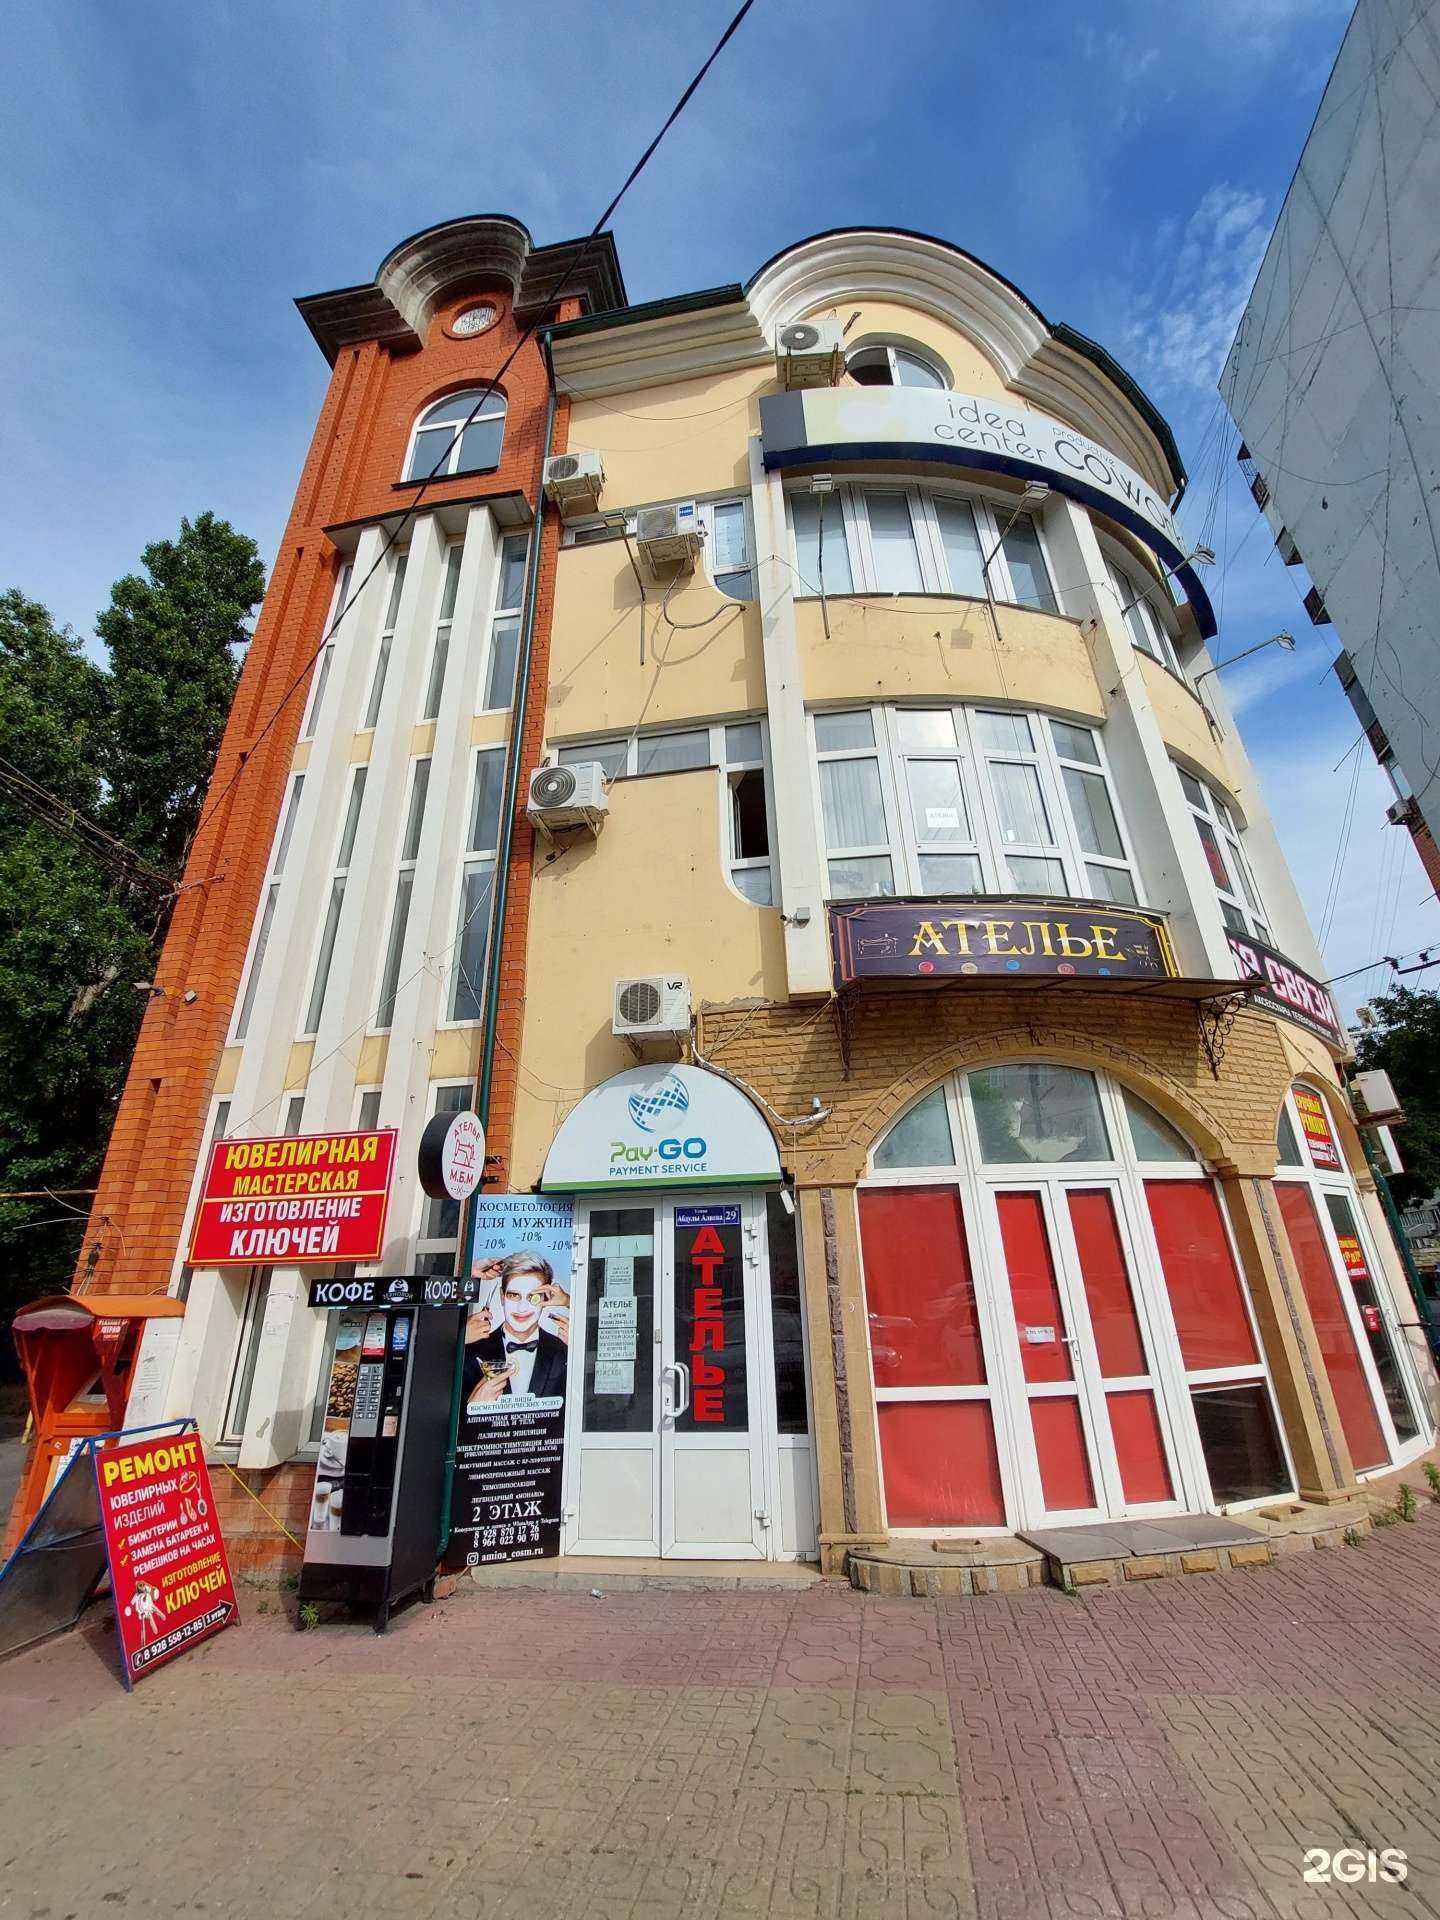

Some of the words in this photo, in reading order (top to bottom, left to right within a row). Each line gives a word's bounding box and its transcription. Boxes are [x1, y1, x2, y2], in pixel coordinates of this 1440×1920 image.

[947, 398, 1026, 437] idea
[934, 424, 1047, 462] center
[908, 921, 1127, 961] АТЕЛЬЕ
[453, 1120, 481, 1142] АТЕЛЬЕ
[225, 1136, 379, 1170] ЮВЕЛИРНАЯ
[232, 1169, 359, 1196] МАСТЕРСКАЯ
[609, 1164, 660, 1176] PAYMENT
[662, 1162, 707, 1173] SERVICE
[220, 1196, 363, 1223] ИЗГОТОВЛЕНИЕ
[479, 1201, 574, 1212] КОСМЕТОЛОГИЯ
[725, 1210, 737, 1221] 29
[477, 1217, 505, 1229] ДЛЯ
[512, 1217, 573, 1229] МУЖЧИН
[230, 1219, 340, 1257] КЛЮЧЕЙ
[479, 1238, 507, 1250] -10%
[515, 1232, 543, 1242] -10%
[547, 1240, 572, 1251] -10%
[315, 1281, 375, 1302] КОФЕ
[424, 1279, 458, 1300] КОФЕ
[688, 1226, 726, 1422] АТЕЛЬЕ
[467, 1414, 508, 1424] АППАРАТНАЯ
[103, 1441, 197, 1488] РЕМОНТ
[110, 1478, 178, 1511] ЮВЕЛИРНЫХ
[114, 1499, 166, 1530] ИЗДЕЛИЙ
[472, 1506, 481, 1522] 2
[489, 1501, 542, 1520] ЭТАЖ
[127, 1519, 178, 1547] БИЖУТЕРИИ
[131, 1540, 165, 1562] ЗАМЕНА
[166, 1528, 202, 1553] БАТАРЕЕК
[203, 1521, 210, 1534] И
[473, 1539, 479, 1548] 8
[500, 1535, 514, 1545] 022
[517, 1534, 527, 1543] 90
[474, 1530, 480, 1539] 8
[483, 1529, 498, 1538] 928
[500, 1526, 515, 1536] 870
[518, 1525, 527, 1534] 17
[530, 1524, 540, 1534] 26
[133, 1552, 179, 1578] РЕМЕШКОВ
[179, 1545, 191, 1559] НА
[191, 1532, 216, 1552] ЧАСАХ
[161, 1551, 221, 1587] ИЗГОТОВЛЕНИЕ
[165, 1564, 227, 1614] КЛЮЧЕЙ
[143, 1649, 150, 1660] 8
[151, 1640, 168, 1656] 928
